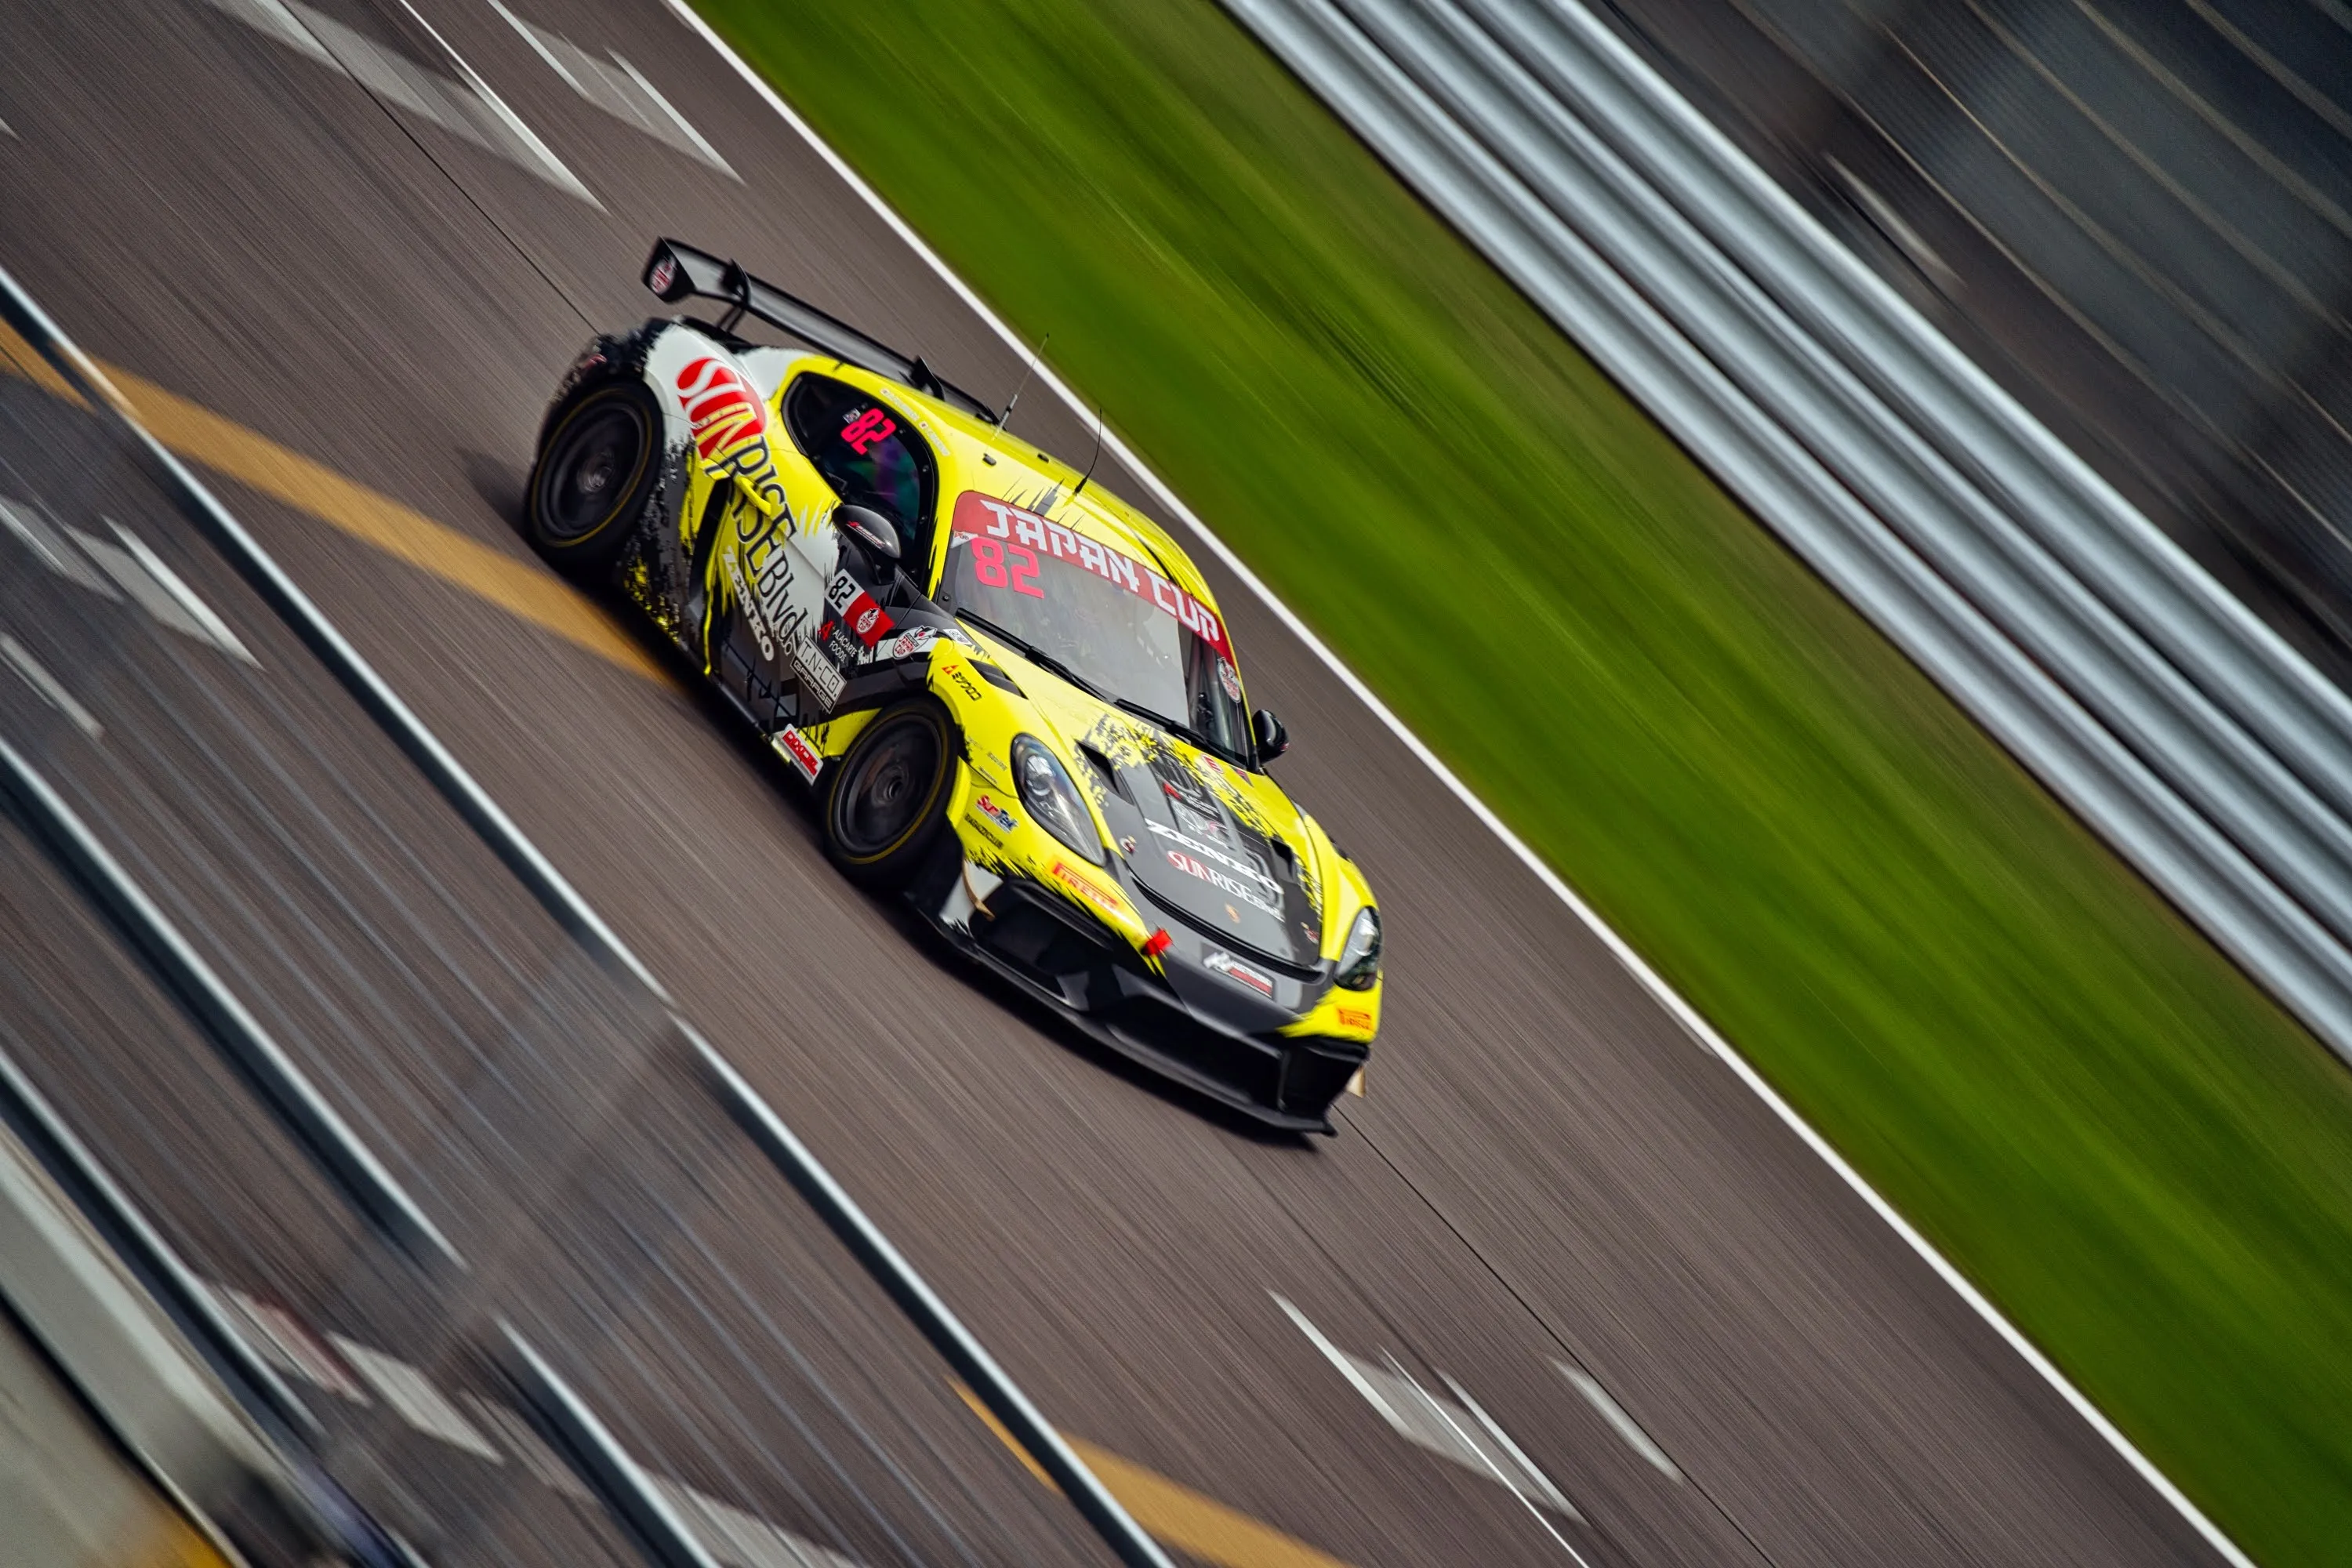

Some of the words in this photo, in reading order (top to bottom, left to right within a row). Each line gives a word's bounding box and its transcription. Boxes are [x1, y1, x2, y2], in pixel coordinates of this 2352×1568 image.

[840, 408, 897, 456] 82
[971, 536, 1044, 599] 82
[980, 499, 1140, 592] JAPAN
[1145, 568, 1219, 641] CUP
[723, 545, 774, 662] ZENKO
[829, 576, 856, 609] 82
[833, 630, 857, 657] ALACARTE
[895, 644, 906, 655] CUP
[898, 636, 913, 652] JAPAN
[793, 659, 833, 709] GARAGE
